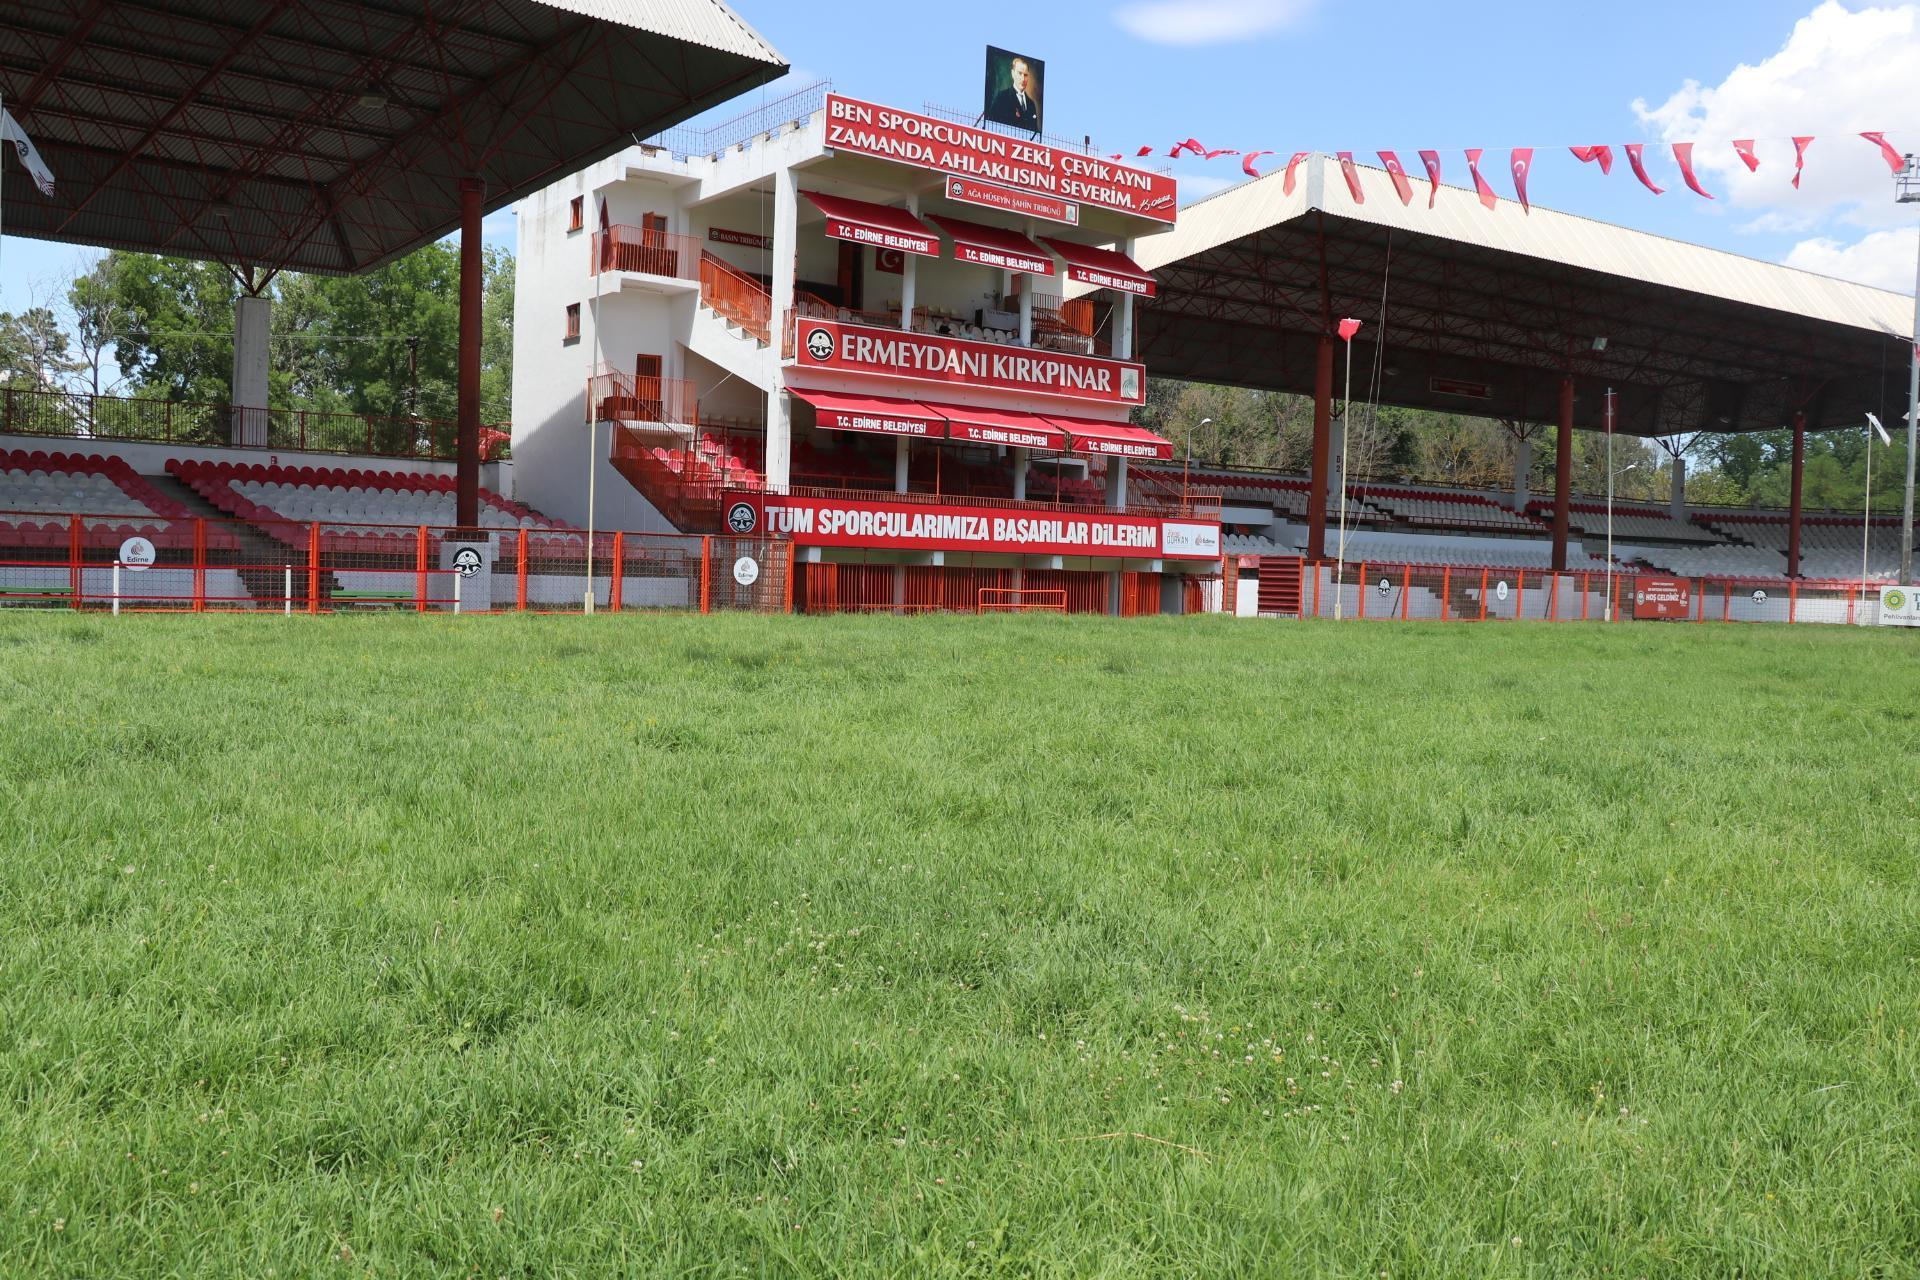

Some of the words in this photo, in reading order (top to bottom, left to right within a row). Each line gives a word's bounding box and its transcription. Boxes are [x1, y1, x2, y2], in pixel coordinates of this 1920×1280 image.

[831, 100, 872, 125] BEN
[878, 111, 1006, 157] SPORCUNUN
[1010, 144, 1055, 172] ZEKİ,
[1060, 156, 1110, 182] ÇEVİK
[1113, 168, 1152, 191] AYNI
[829, 124, 935, 164] ZAMANDA
[939, 150, 1056, 191] AHLAKLISINI
[1060, 178, 1136, 209] SEVERİM.
[967, 188, 982, 199] AĞA
[838, 224, 852, 238] T.C.
[854, 228, 883, 244] EDİRNE
[884, 234, 928, 253] BELEDİYESİ
[965, 248, 978, 261] T.C.
[979, 251, 1005, 266] EDİRNE
[1006, 256, 1045, 273] BELEDİYESİ
[1076, 270, 1088, 281] T.C.
[1089, 272, 1112, 286] EDİRNE
[1112, 277, 1147, 293] BELEDİYESİ
[841, 334, 987, 378] ERMEYDANI
[993, 354, 1112, 393] KIRKPINAR
[836, 415, 851, 427] T.C.
[852, 416, 881, 430] EDİRNE
[883, 420, 926, 434] BELEDİYESİ
[968, 427, 981, 439] T.C.
[982, 429, 1008, 442] EDİRNE
[1009, 433, 1048, 447] BELEDİYESİ
[1088, 440, 1099, 451] T.C.
[1100, 441, 1122, 454] EDİRNE
[1123, 444, 1157, 457] BELEDİYESİ
[765, 505, 814, 533] TÜM
[818, 508, 990, 541] SPORCULARIMIZA
[993, 517, 1088, 545] BAŞARILAR
